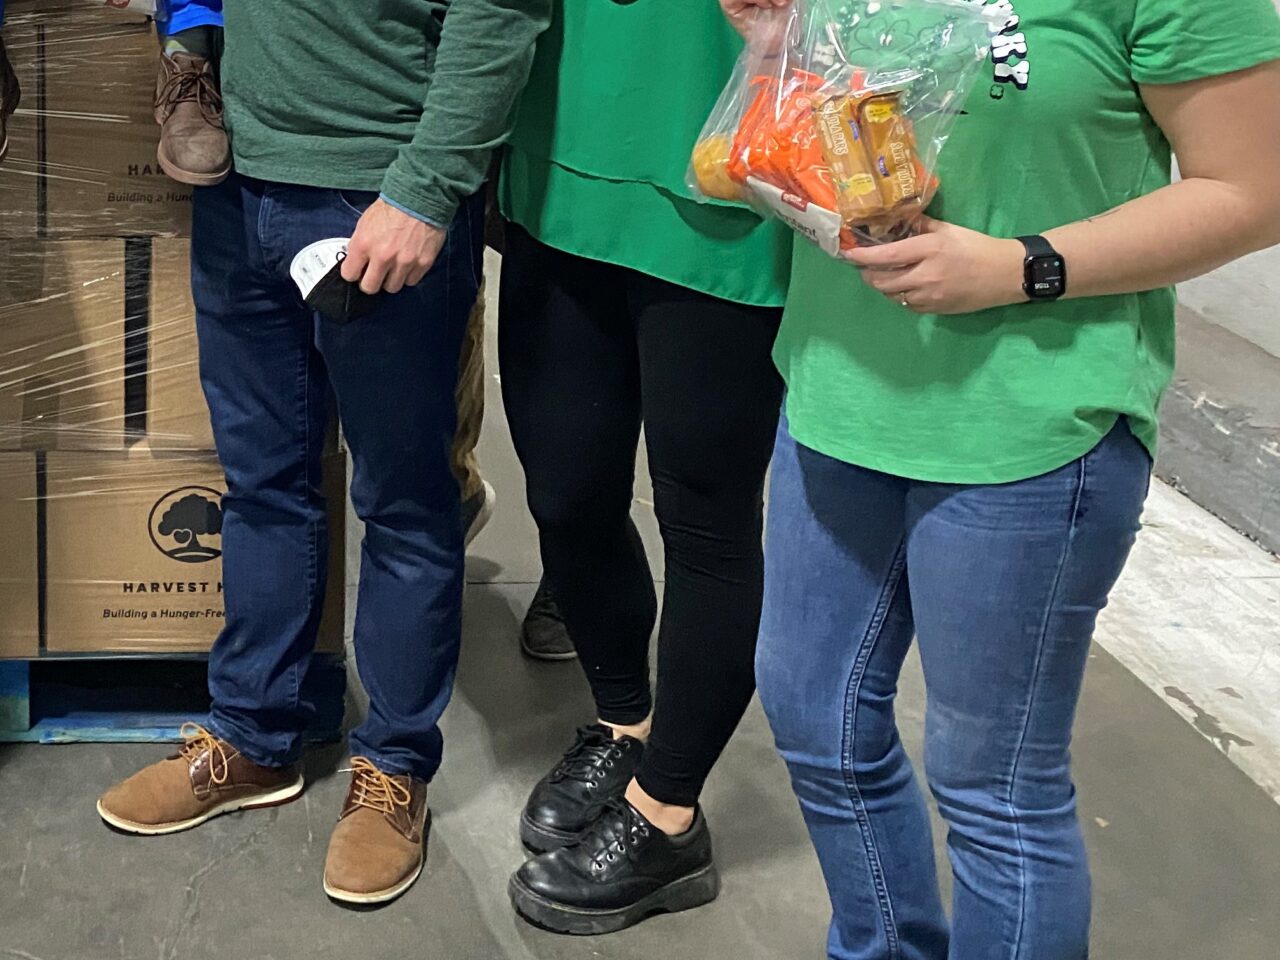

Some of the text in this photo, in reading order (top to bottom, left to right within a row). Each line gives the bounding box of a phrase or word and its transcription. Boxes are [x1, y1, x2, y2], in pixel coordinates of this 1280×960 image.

[107, 192, 153, 204] Building
[123, 582, 209, 593] HARVEST
[103, 608, 148, 620] Building
[151, 610, 157, 618] a
